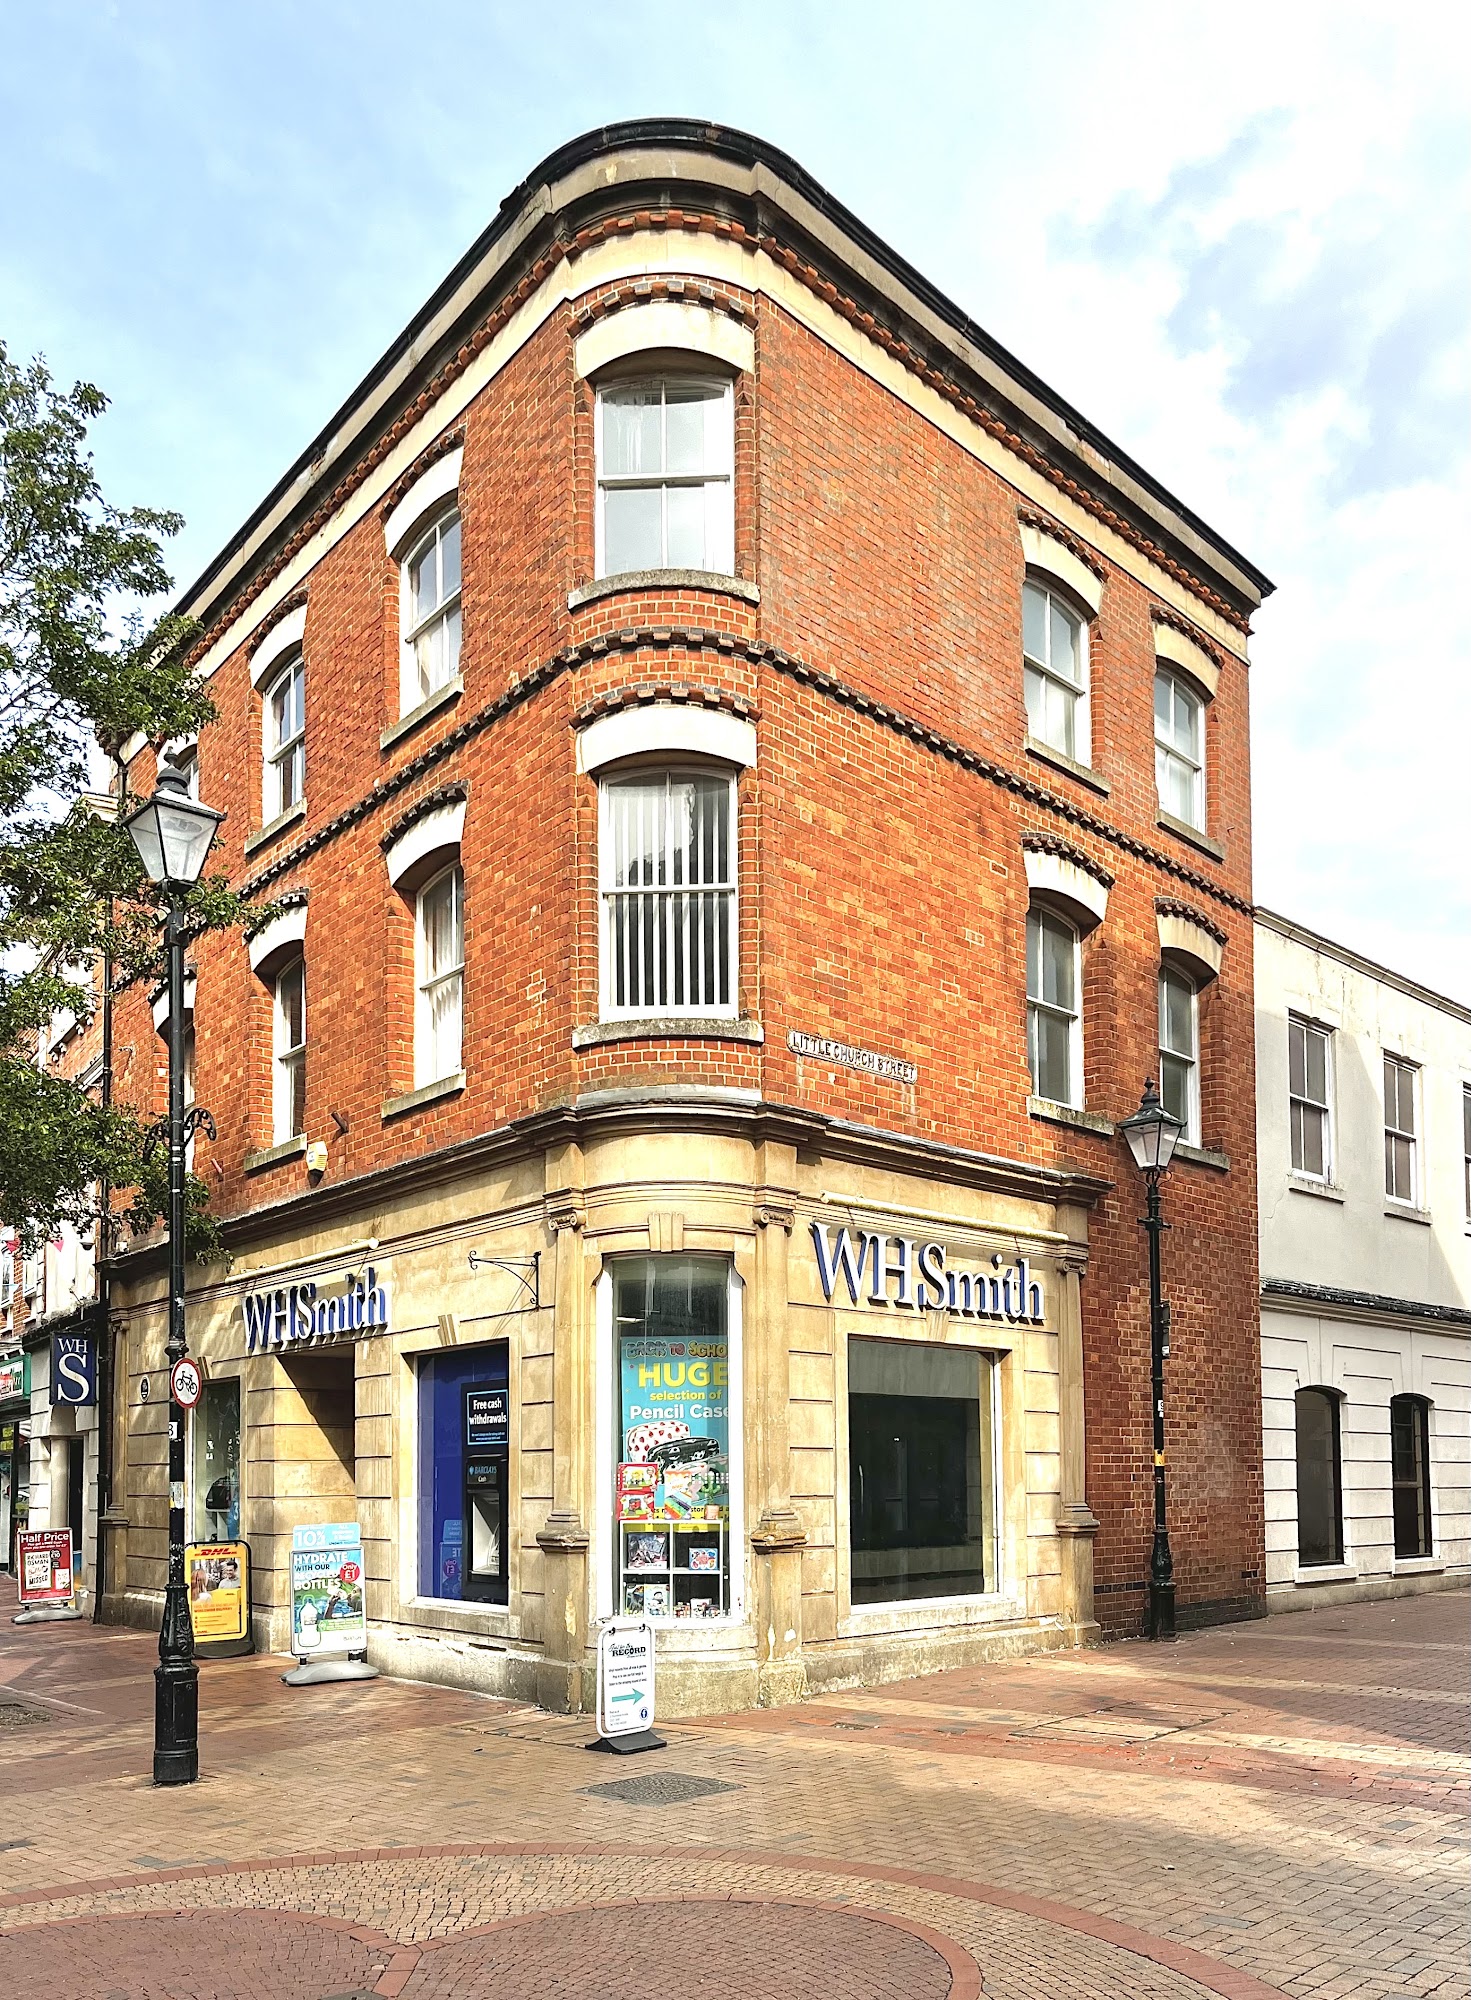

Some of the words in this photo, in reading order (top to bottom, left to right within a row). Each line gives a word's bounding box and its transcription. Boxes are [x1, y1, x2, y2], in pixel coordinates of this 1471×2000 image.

[793, 1032, 831, 1056] LITTLE
[833, 1044, 875, 1069] CHURCH
[877, 1058, 915, 1079] STREET
[809, 1219, 1046, 1322] WHSmith
[242, 1267, 388, 1349] WHSmith
[58, 1338, 88, 1353] WH
[626, 1340, 667, 1358] BACK
[669, 1342, 686, 1356] TO
[688, 1340, 728, 1358] SCHO
[57, 1352, 90, 1402] S
[638, 1362, 728, 1388] HUGE
[649, 1390, 705, 1401] selection
[709, 1389, 722, 1400] of
[473, 1399, 487, 1410] Free
[487, 1397, 502, 1409] cash
[468, 1411, 507, 1425] withdrawals
[630, 1404, 685, 1420] Pencil
[474, 1465, 497, 1474] BARCLAYS
[20, 1533, 42, 1544] Half
[44, 1532, 69, 1542] Price
[200, 1547, 232, 1556] DHL
[294, 1551, 348, 1565] HYDRATE
[294, 1564, 313, 1572] WITH
[344, 1569, 355, 1579] £1
[28, 1575, 49, 1585] MISSED
[294, 1578, 341, 1591] BOTTLES
[612, 1646, 646, 1658] RECORD
